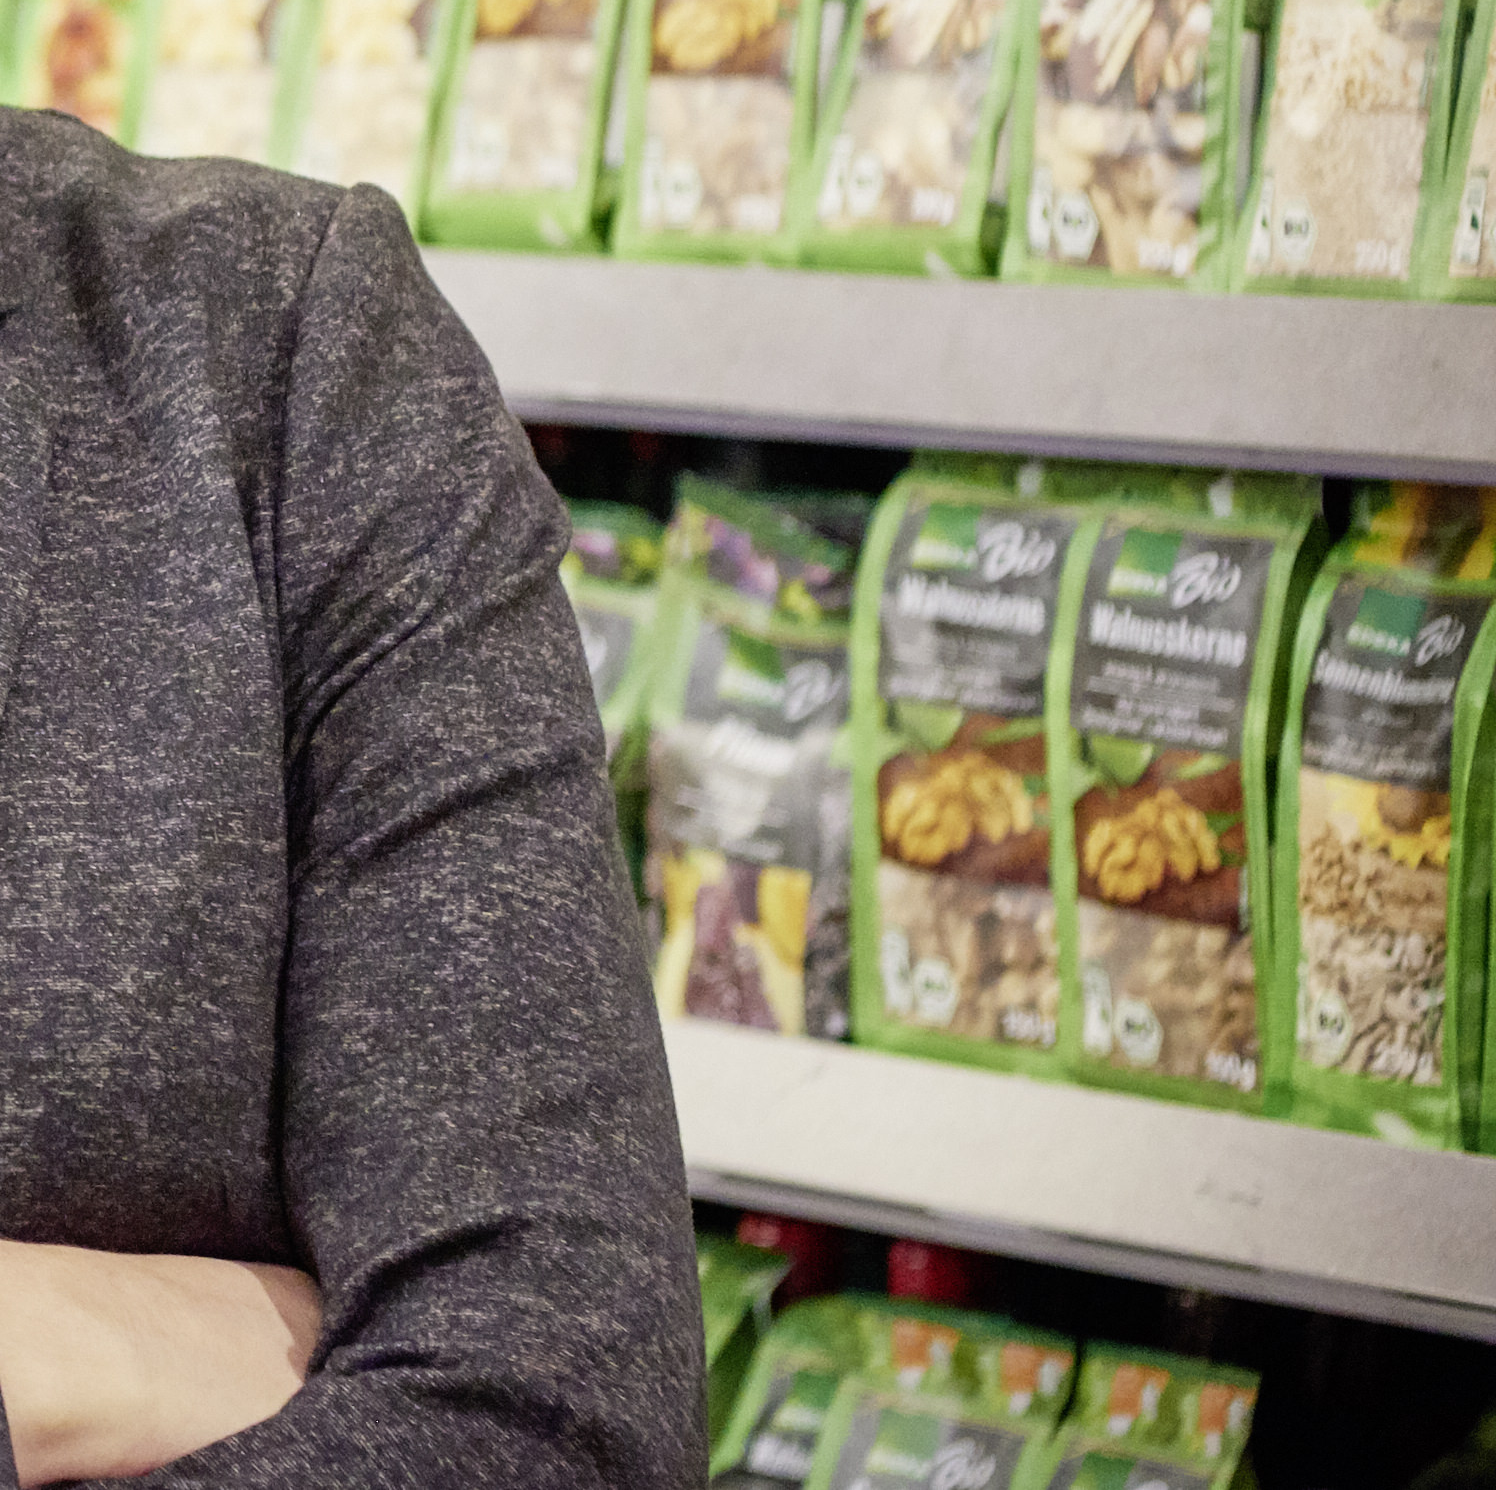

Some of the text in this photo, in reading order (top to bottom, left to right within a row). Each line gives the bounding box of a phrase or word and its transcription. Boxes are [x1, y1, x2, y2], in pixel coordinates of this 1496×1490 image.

[980, 521, 1057, 583] Bio
[1170, 550, 1241, 609] Bio
[1089, 599, 1248, 667] Walnusskerne
[1415, 615, 1466, 667] Bio
